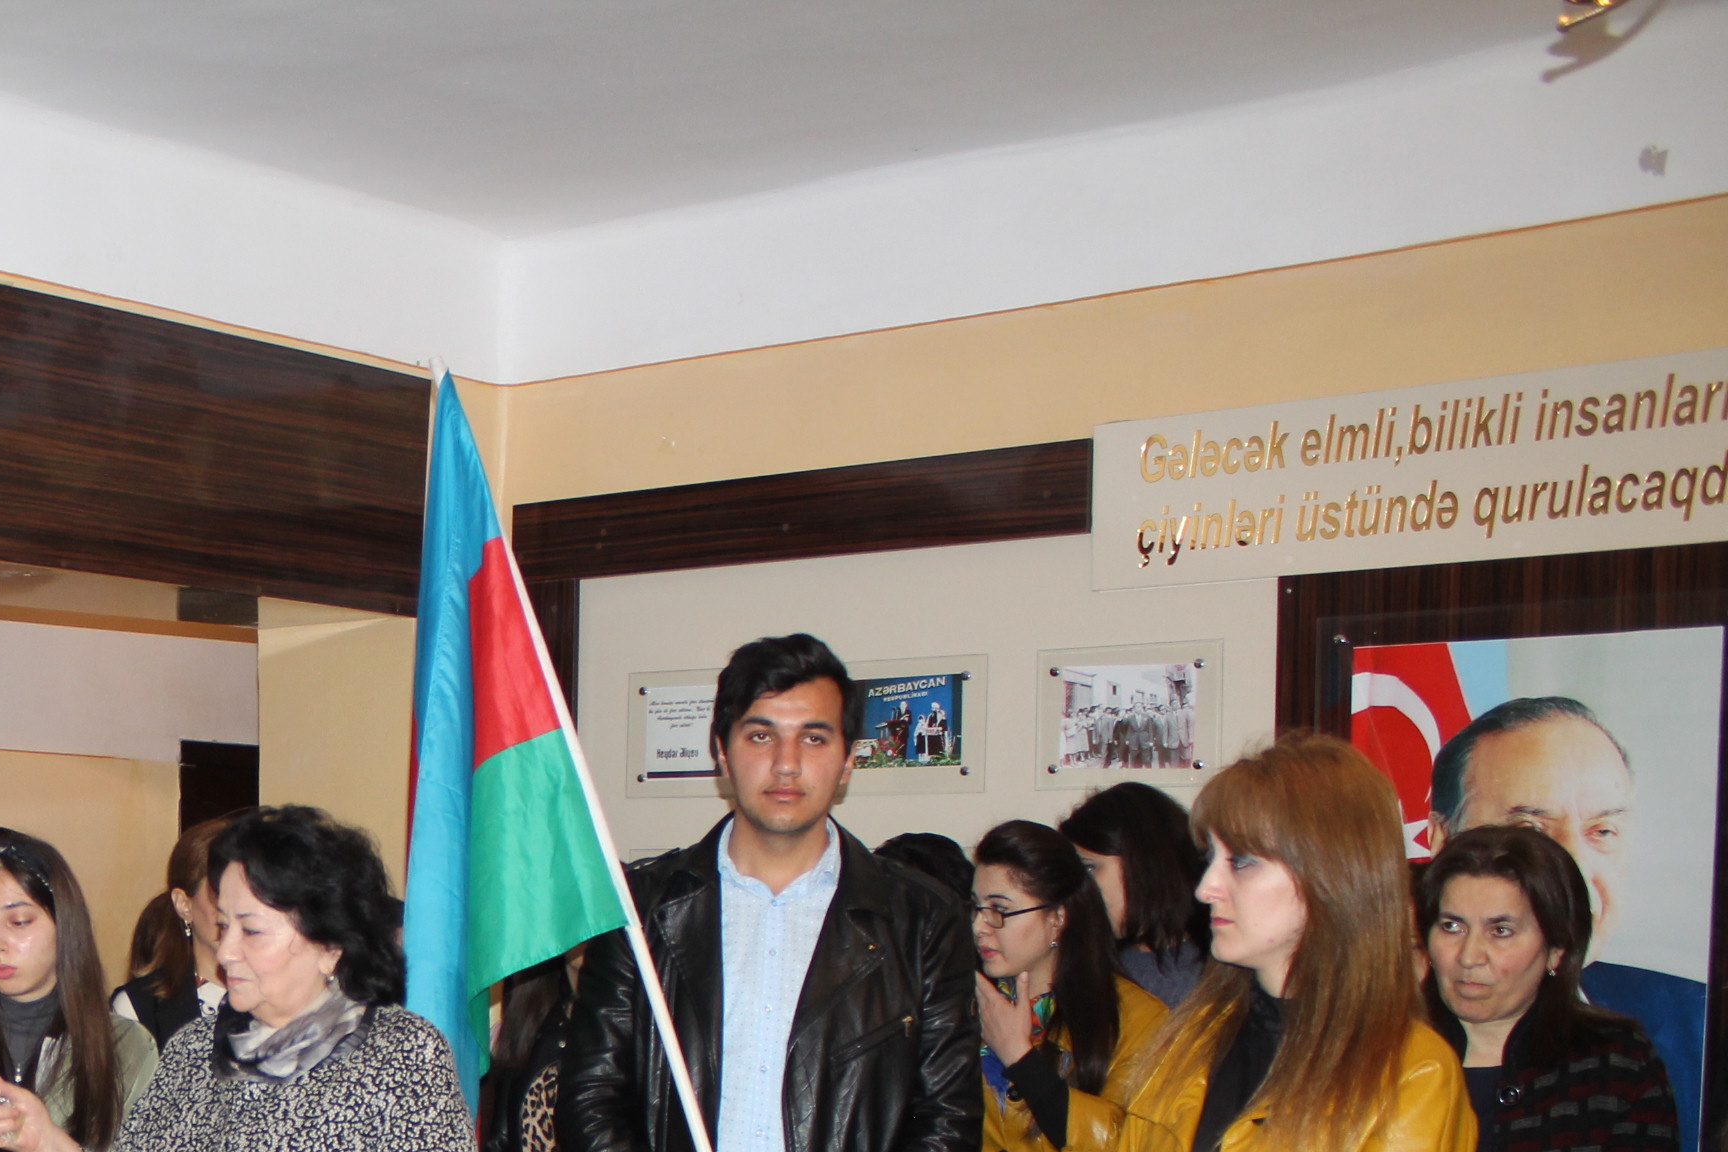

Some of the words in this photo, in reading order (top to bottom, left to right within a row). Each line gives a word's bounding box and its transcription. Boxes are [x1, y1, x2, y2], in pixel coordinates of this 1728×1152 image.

[1139, 420, 1287, 484] Gələcək
[1136, 494, 1285, 567] çiyinləri
[1296, 480, 1458, 543] üstündə
[868, 676, 947, 697] AZƏRBAYCAN
